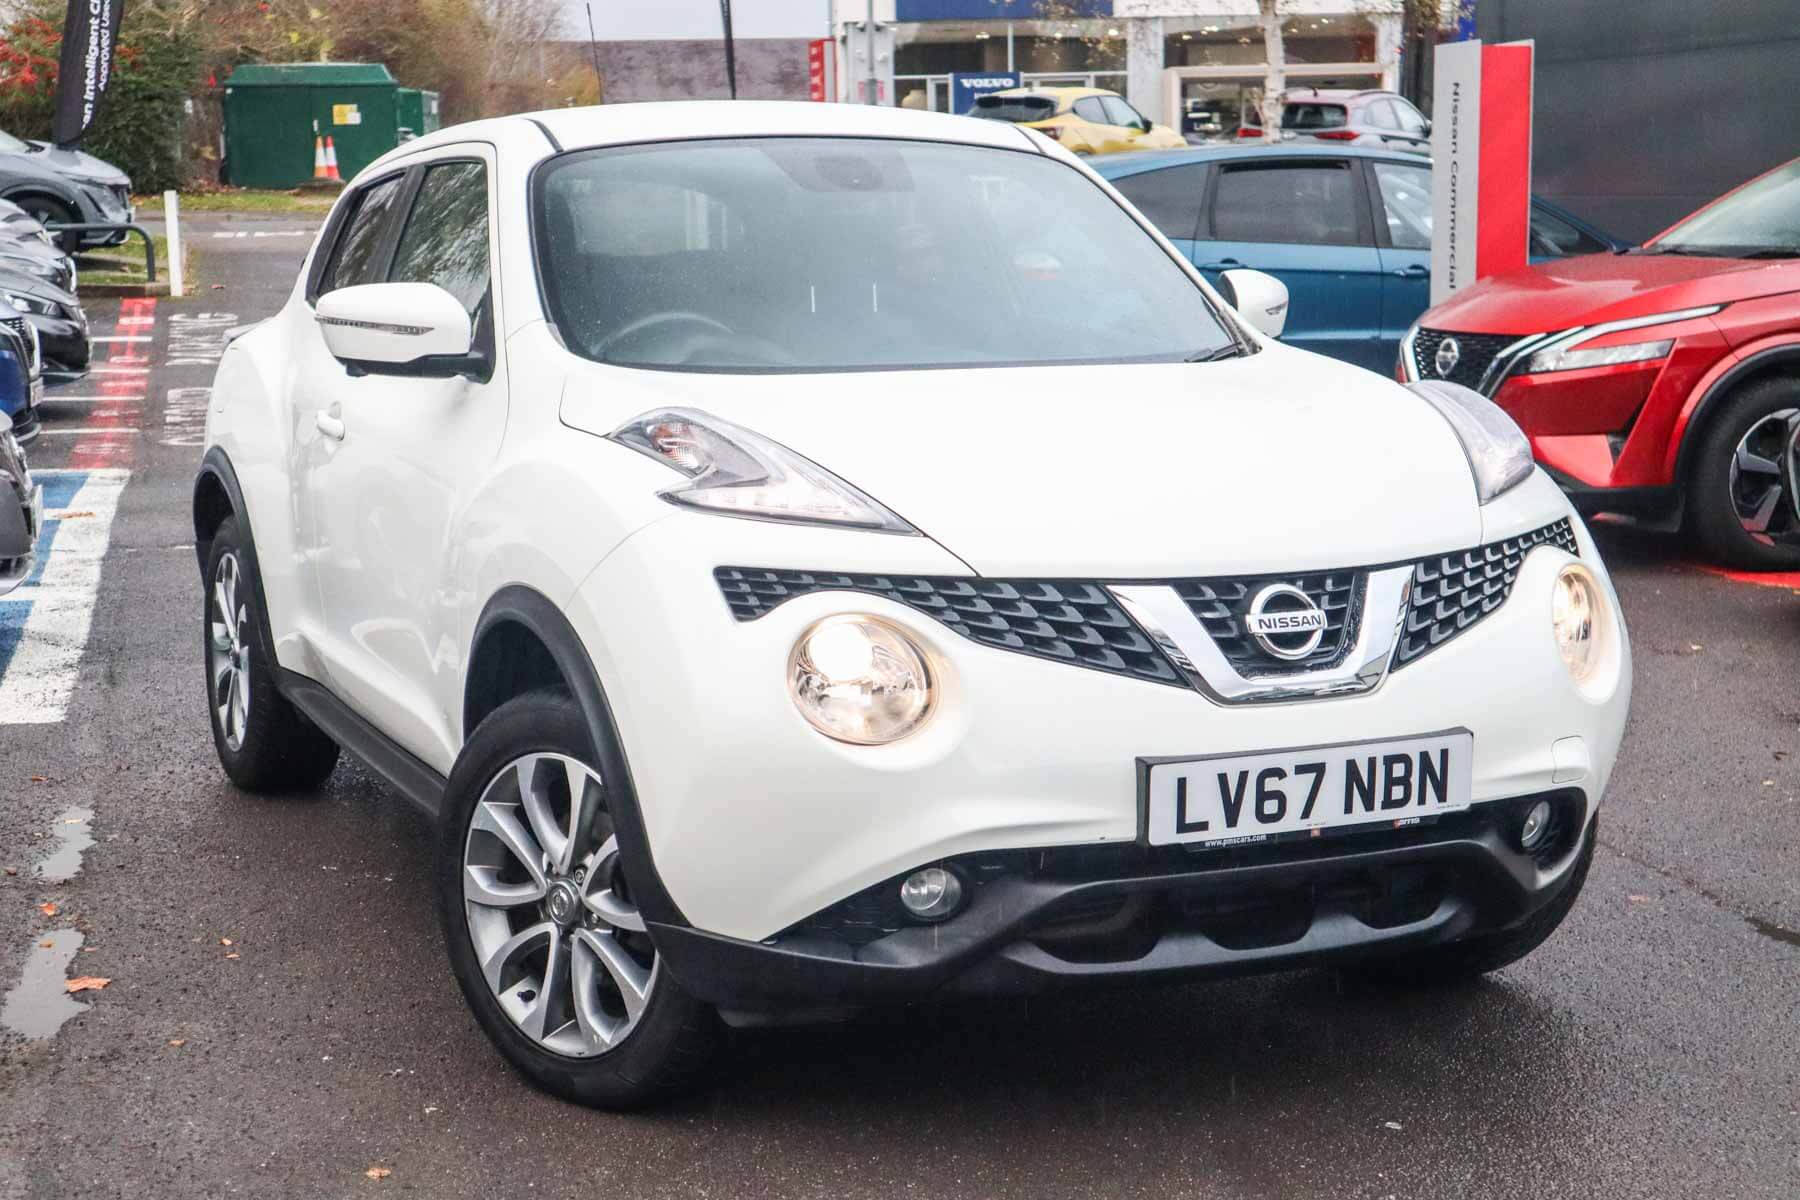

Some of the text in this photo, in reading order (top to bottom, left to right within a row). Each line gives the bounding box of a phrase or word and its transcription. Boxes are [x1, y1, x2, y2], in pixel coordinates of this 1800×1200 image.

[84, 16, 100, 100] Intelligent
[99, 28, 110, 91] Approved
[960, 78, 1015, 88] VOLVO
[1449, 82, 1460, 289] Nissan Commercial
[1257, 615, 1322, 630] NISSAN
[1175, 748, 1450, 835] LV67 NBN
[1204, 834, 1267, 848] www.pmscars.com
